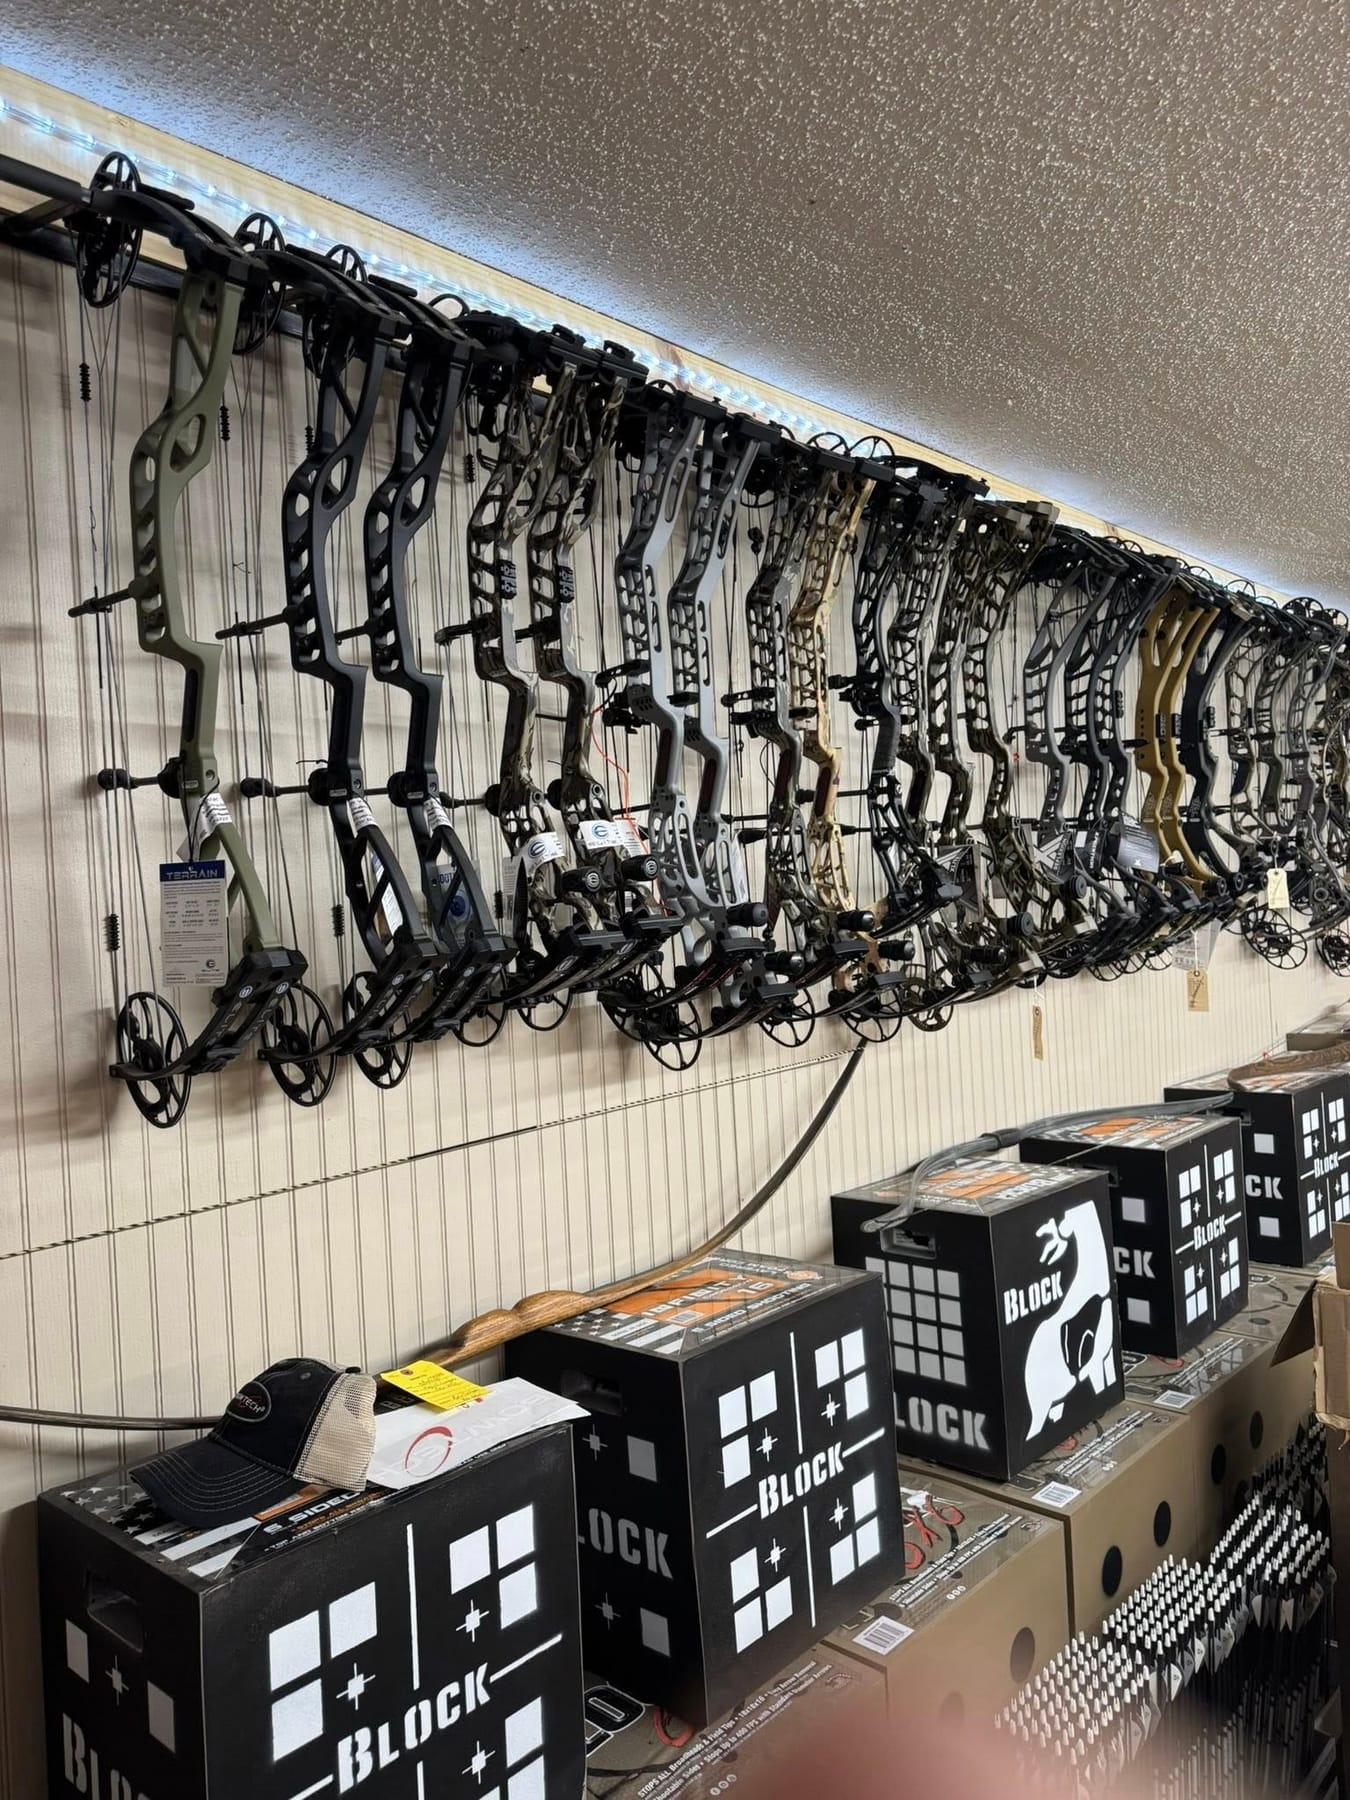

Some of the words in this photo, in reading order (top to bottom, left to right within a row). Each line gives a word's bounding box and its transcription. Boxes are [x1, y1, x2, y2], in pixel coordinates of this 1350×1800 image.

[166, 868, 218, 880] TERRAIN
[1313, 1150, 1340, 1179] BLOCK
[1193, 1214, 1227, 1251] BLOCK
[1003, 1270, 1064, 1326] BLOCK
[893, 1391, 991, 1451] LOCK
[758, 1440, 845, 1520] BLOCK
[577, 1507, 674, 1580] OCK
[337, 1661, 491, 1796] BLOCK
[637, 1778, 660, 1798] STOPS
[657, 1769, 672, 1781] ALL
[668, 1743, 705, 1772] Broadheads
[707, 1726, 725, 1741] Field
[720, 1718, 736, 1731] Tips
[652, 1778, 685, 1800] hootable
[682, 1763, 701, 1779] Sides
[703, 1747, 723, 1763] Stops
[745, 1718, 759, 1731] FPS
